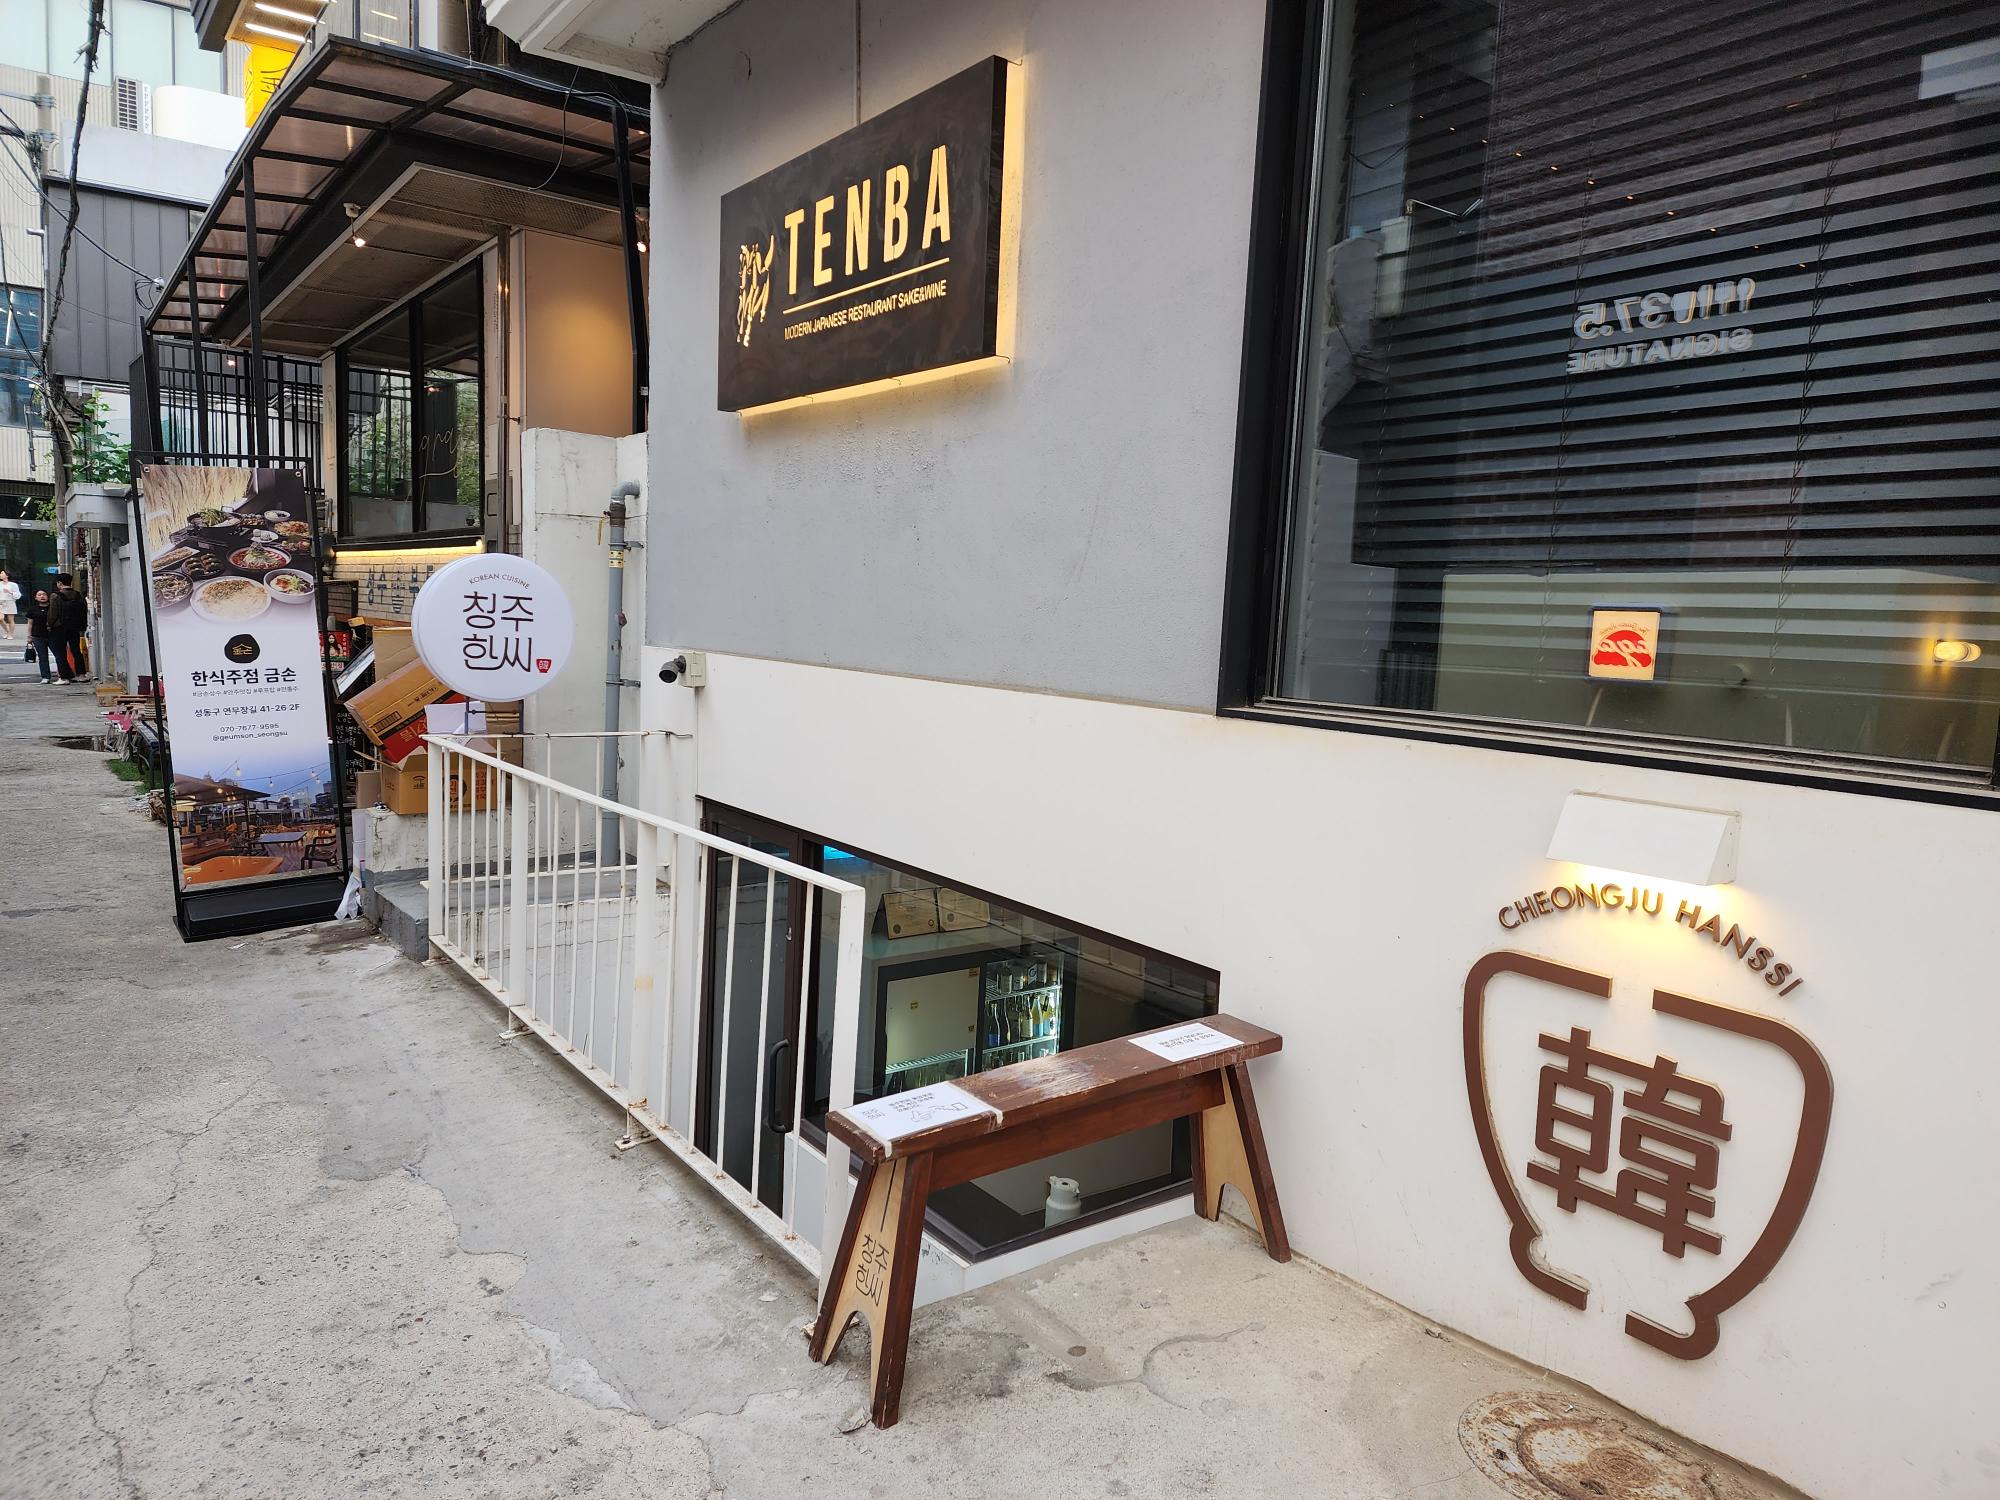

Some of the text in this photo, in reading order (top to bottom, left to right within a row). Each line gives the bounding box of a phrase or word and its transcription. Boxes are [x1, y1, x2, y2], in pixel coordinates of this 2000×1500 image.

[784, 144, 951, 296] TENBA
[784, 279, 947, 341] MODERN JAPANESE RESTAURANT SAKE&WINE
[469, 573, 530, 589] KOREAN CUISINE
[463, 591, 534, 632] 청주
[463, 633, 532, 672] 한씨
[191, 667, 297, 687] 한식주점 금손
[194, 703, 300, 718] 성동구 연무장길 41-26 2F
[213, 730, 288, 741] @geumson_seongsu
[1498, 883, 1804, 998] CHEONGJU HANSSI
[1526, 1024, 1733, 1259] 韓
[862, 1233, 890, 1274] 청주
[855, 1263, 884, 1308] 한씨
